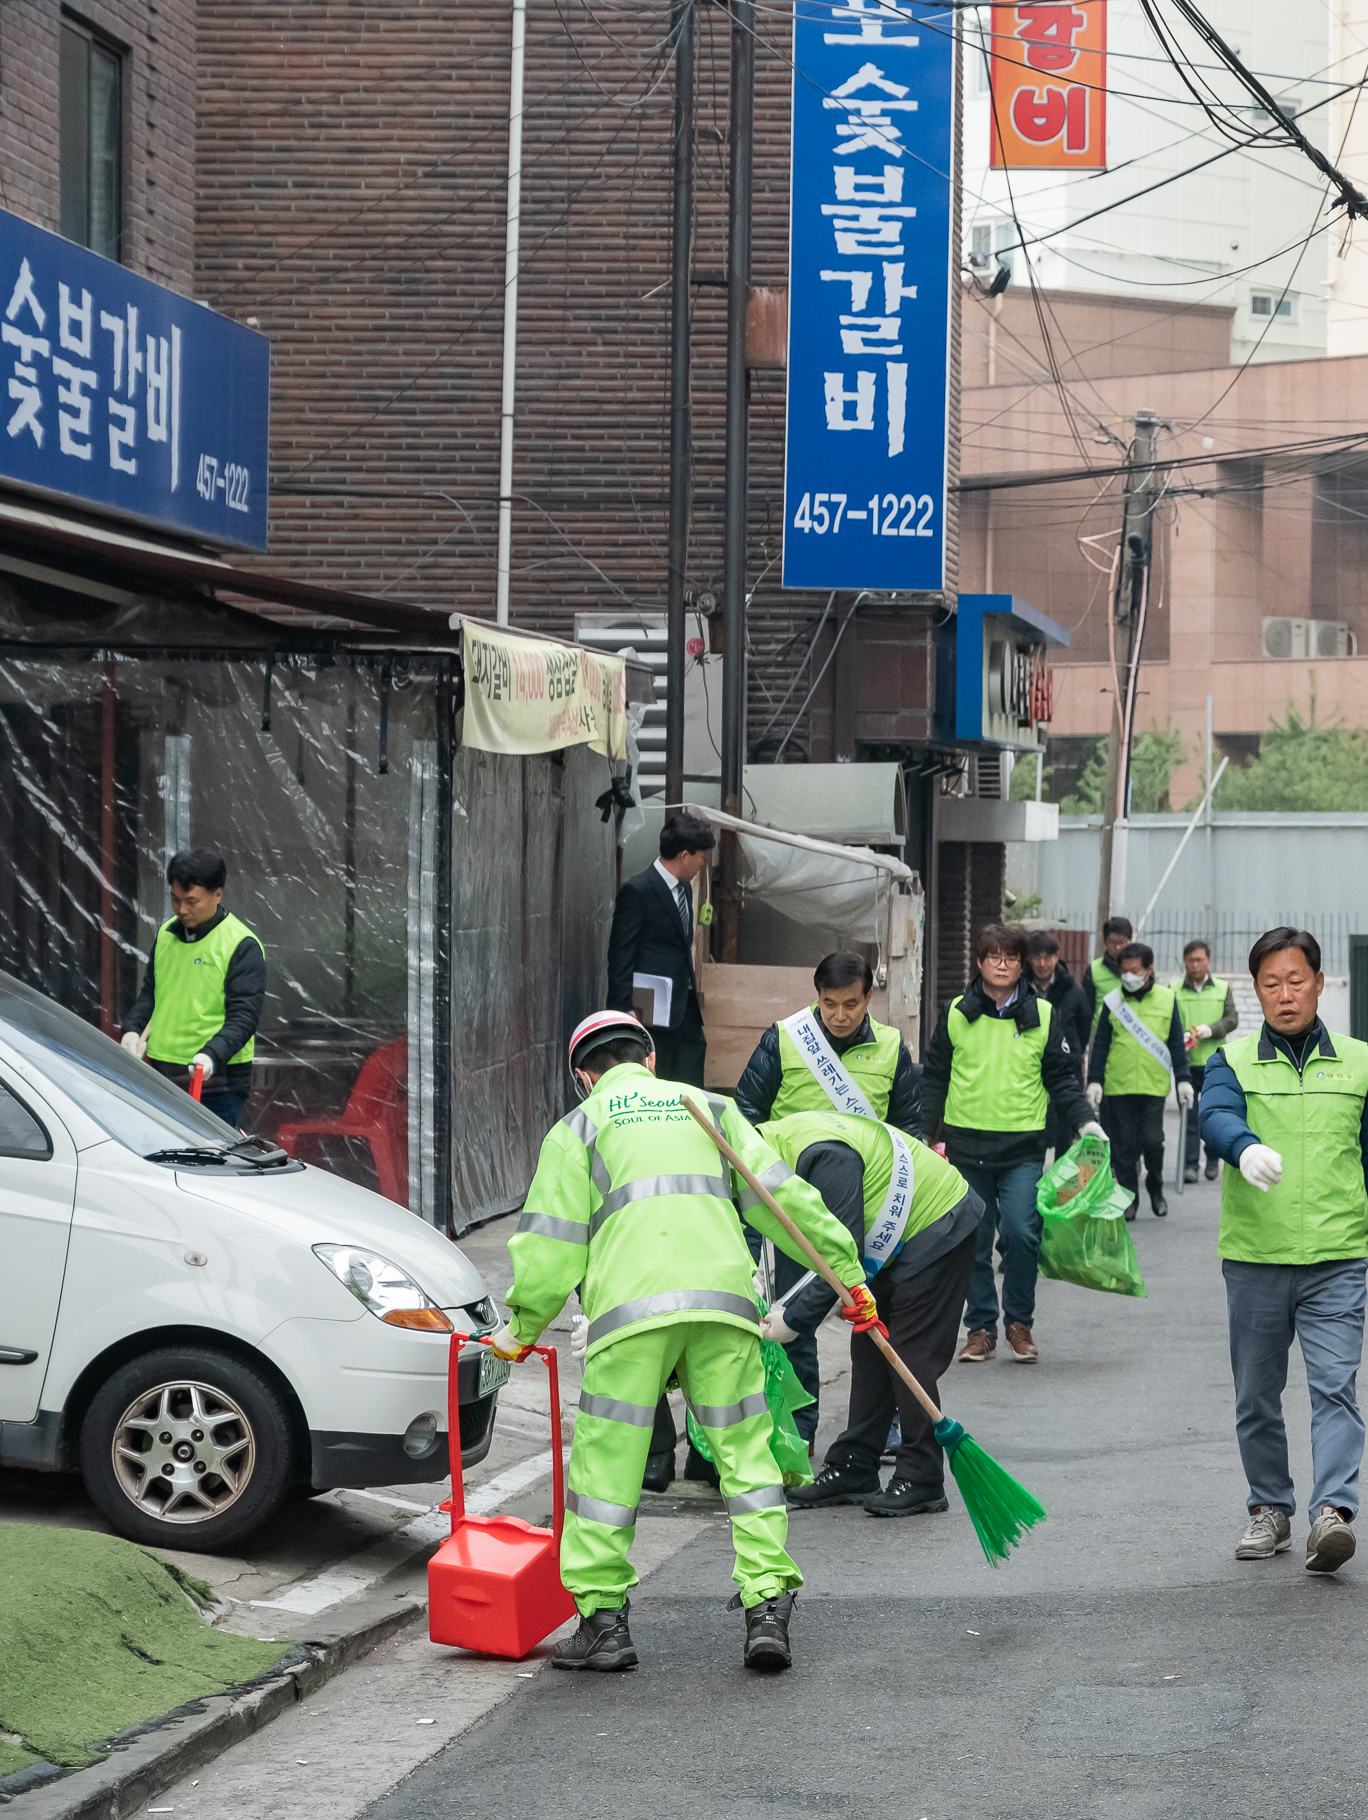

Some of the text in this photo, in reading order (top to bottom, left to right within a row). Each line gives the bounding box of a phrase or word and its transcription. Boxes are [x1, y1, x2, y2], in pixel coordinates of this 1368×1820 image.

[1, 256, 183, 493] 숯불갈비
[196, 452, 250, 514] 457-1222
[793, 491, 934, 538] 457-1222
[511, 649, 545, 707] 14,000
[797, 1023, 822, 1056] 내집앞
[816, 1055, 850, 1097] 쓰레기는
[845, 1096, 868, 1116] 스스
[614, 1116, 646, 1129] SOUL
[665, 1114, 692, 1122] ASIA
[898, 1152, 910, 1190] 스스로
[889, 1193, 907, 1219] 치워
[868, 1219, 898, 1252] 주세요
